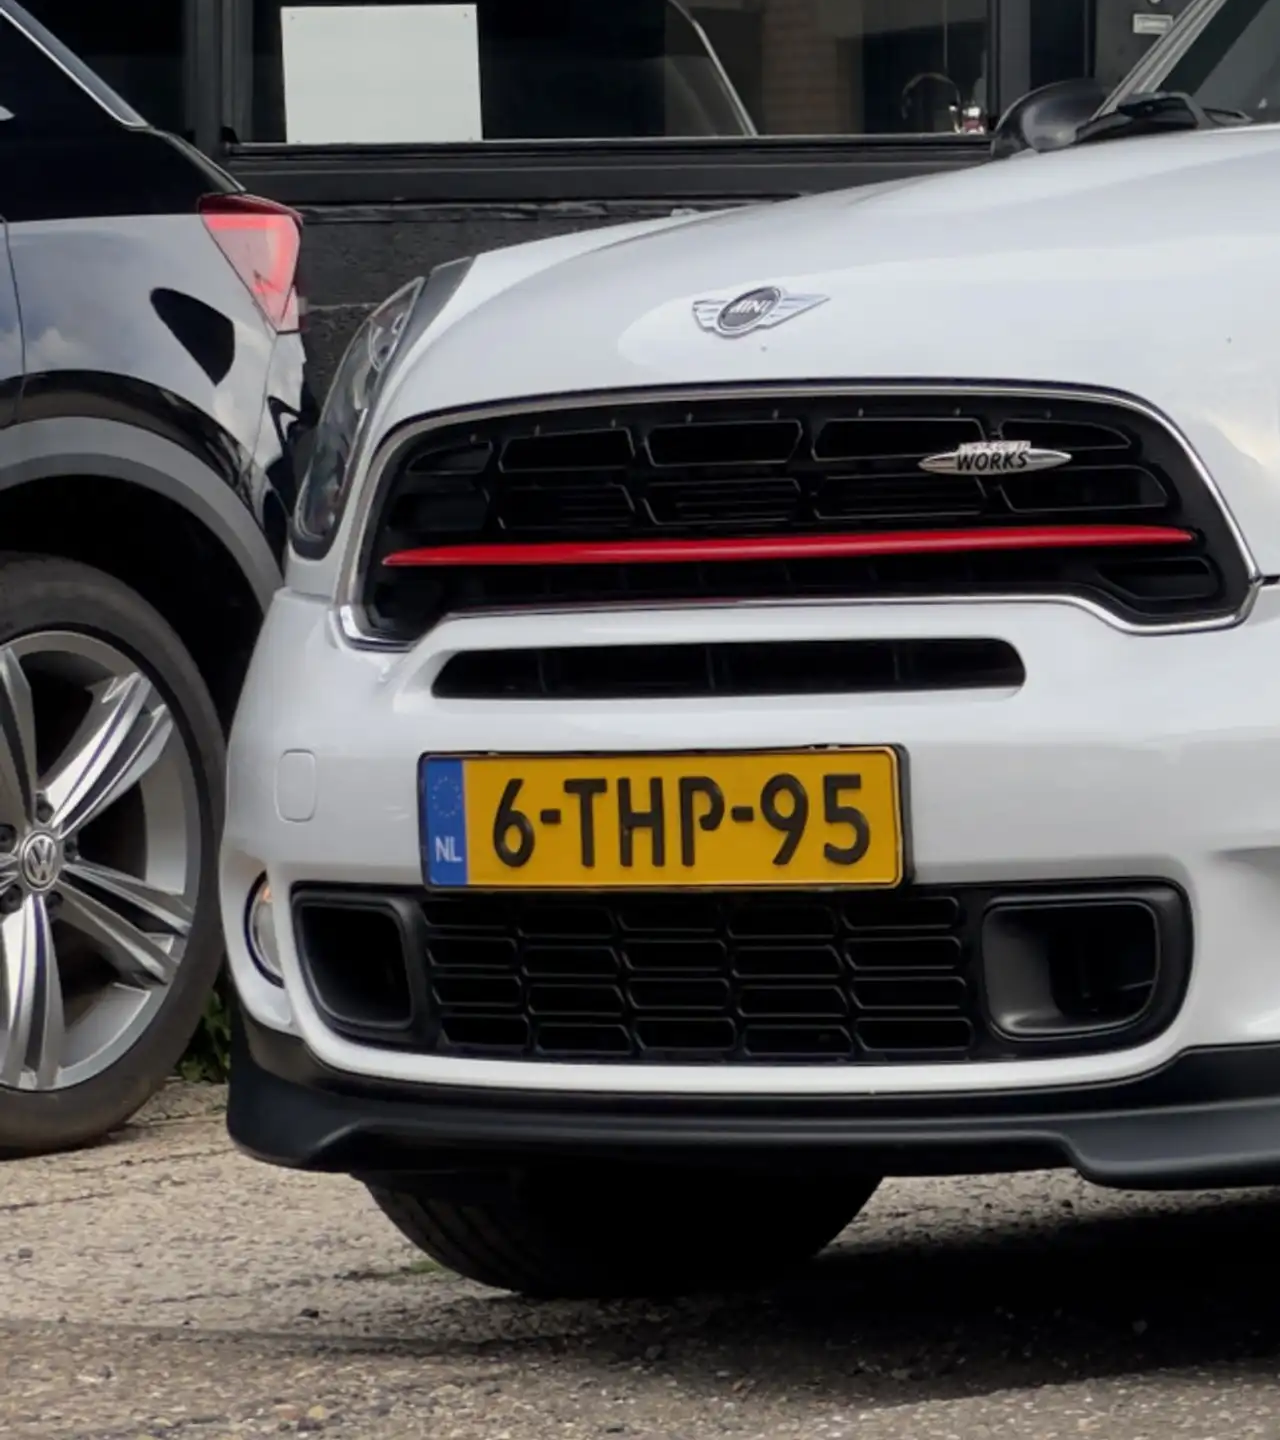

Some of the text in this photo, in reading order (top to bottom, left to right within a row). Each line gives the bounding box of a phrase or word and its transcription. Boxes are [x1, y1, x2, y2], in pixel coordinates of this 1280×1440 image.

[955, 450, 1029, 471] WORKS
[492, 773, 871, 868] 6-THP-95
[434, 835, 463, 864] NL
